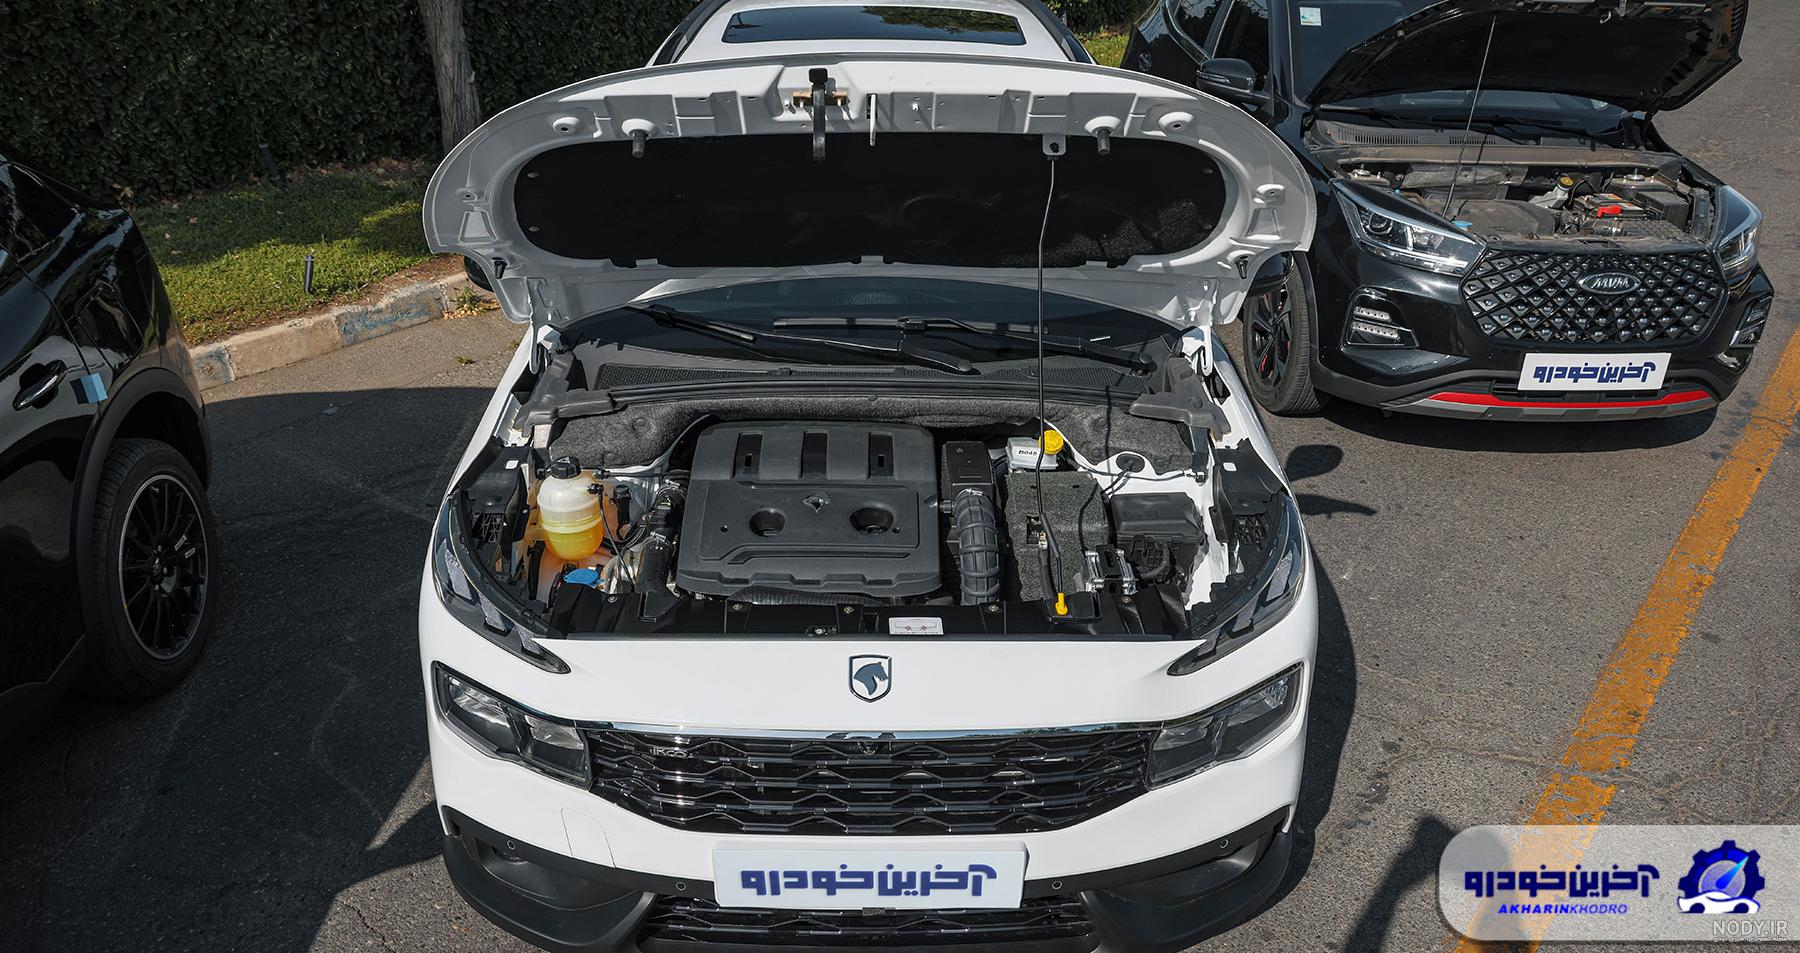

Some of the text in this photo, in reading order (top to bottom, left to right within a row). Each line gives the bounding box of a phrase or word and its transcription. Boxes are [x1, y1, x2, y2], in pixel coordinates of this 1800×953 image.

[1591, 277, 1630, 288] MVM
[1533, 361, 1657, 383] آخرین خودرو
[741, 863, 998, 896] آخرین خودرو
